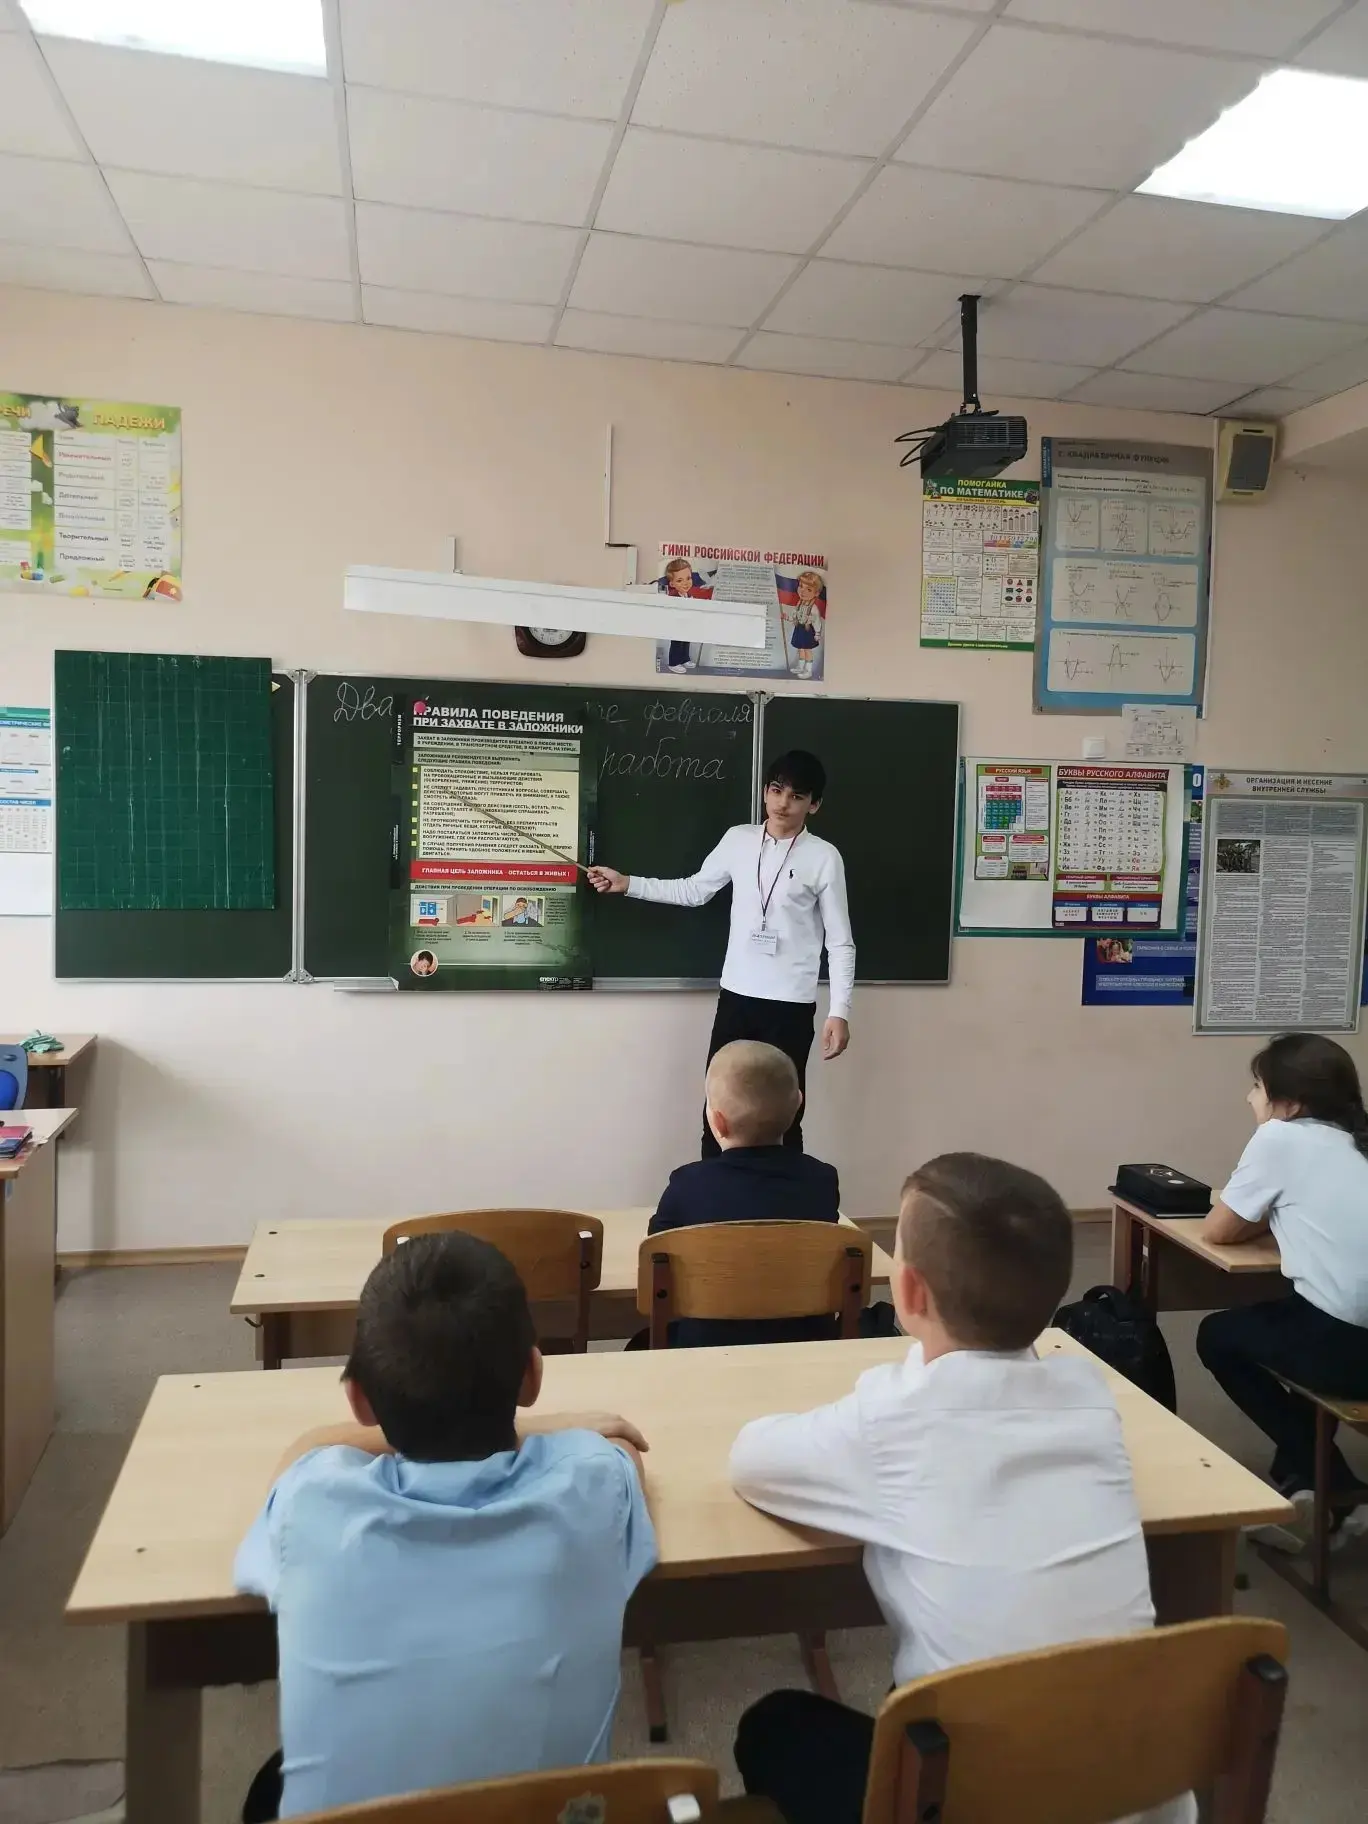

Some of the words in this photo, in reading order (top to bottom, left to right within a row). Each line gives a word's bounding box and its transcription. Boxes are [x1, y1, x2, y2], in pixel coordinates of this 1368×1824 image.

[0, 406, 30, 418] ЕЧИ
[93, 414, 165, 430] ПАДЕЖИ
[958, 480, 1007, 488] ПОМОГАЙКА
[940, 486, 954, 494] ПО
[957, 488, 1024, 498] МАТЕМАТИКЕ
[59, 532, 109, 541] Творительный
[60, 553, 105, 562] Предложный
[662, 544, 690, 556] ГИМН
[694, 546, 760, 562] РОССИЙСКОЙ
[764, 552, 824, 567] ФЕДЕРАЦИИ
[334, 682, 393, 722] Два
[644, 698, 753, 736] февраля
[482, 709, 564, 723] ПОВЕДЕНИЯ
[413, 717, 438, 727] ПРИ
[441, 718, 494, 730] ЗАХВАТЕ
[498, 721, 505, 730] В
[509, 722, 583, 733] ЗАЛОЖНИКИ
[598, 737, 725, 782] работа
[1087, 769, 1124, 778] РУССКОГО
[1126, 770, 1166, 779] АЛФАВИТА
[1246, 777, 1295, 785] ОРГАНИЗАЦИЯ
